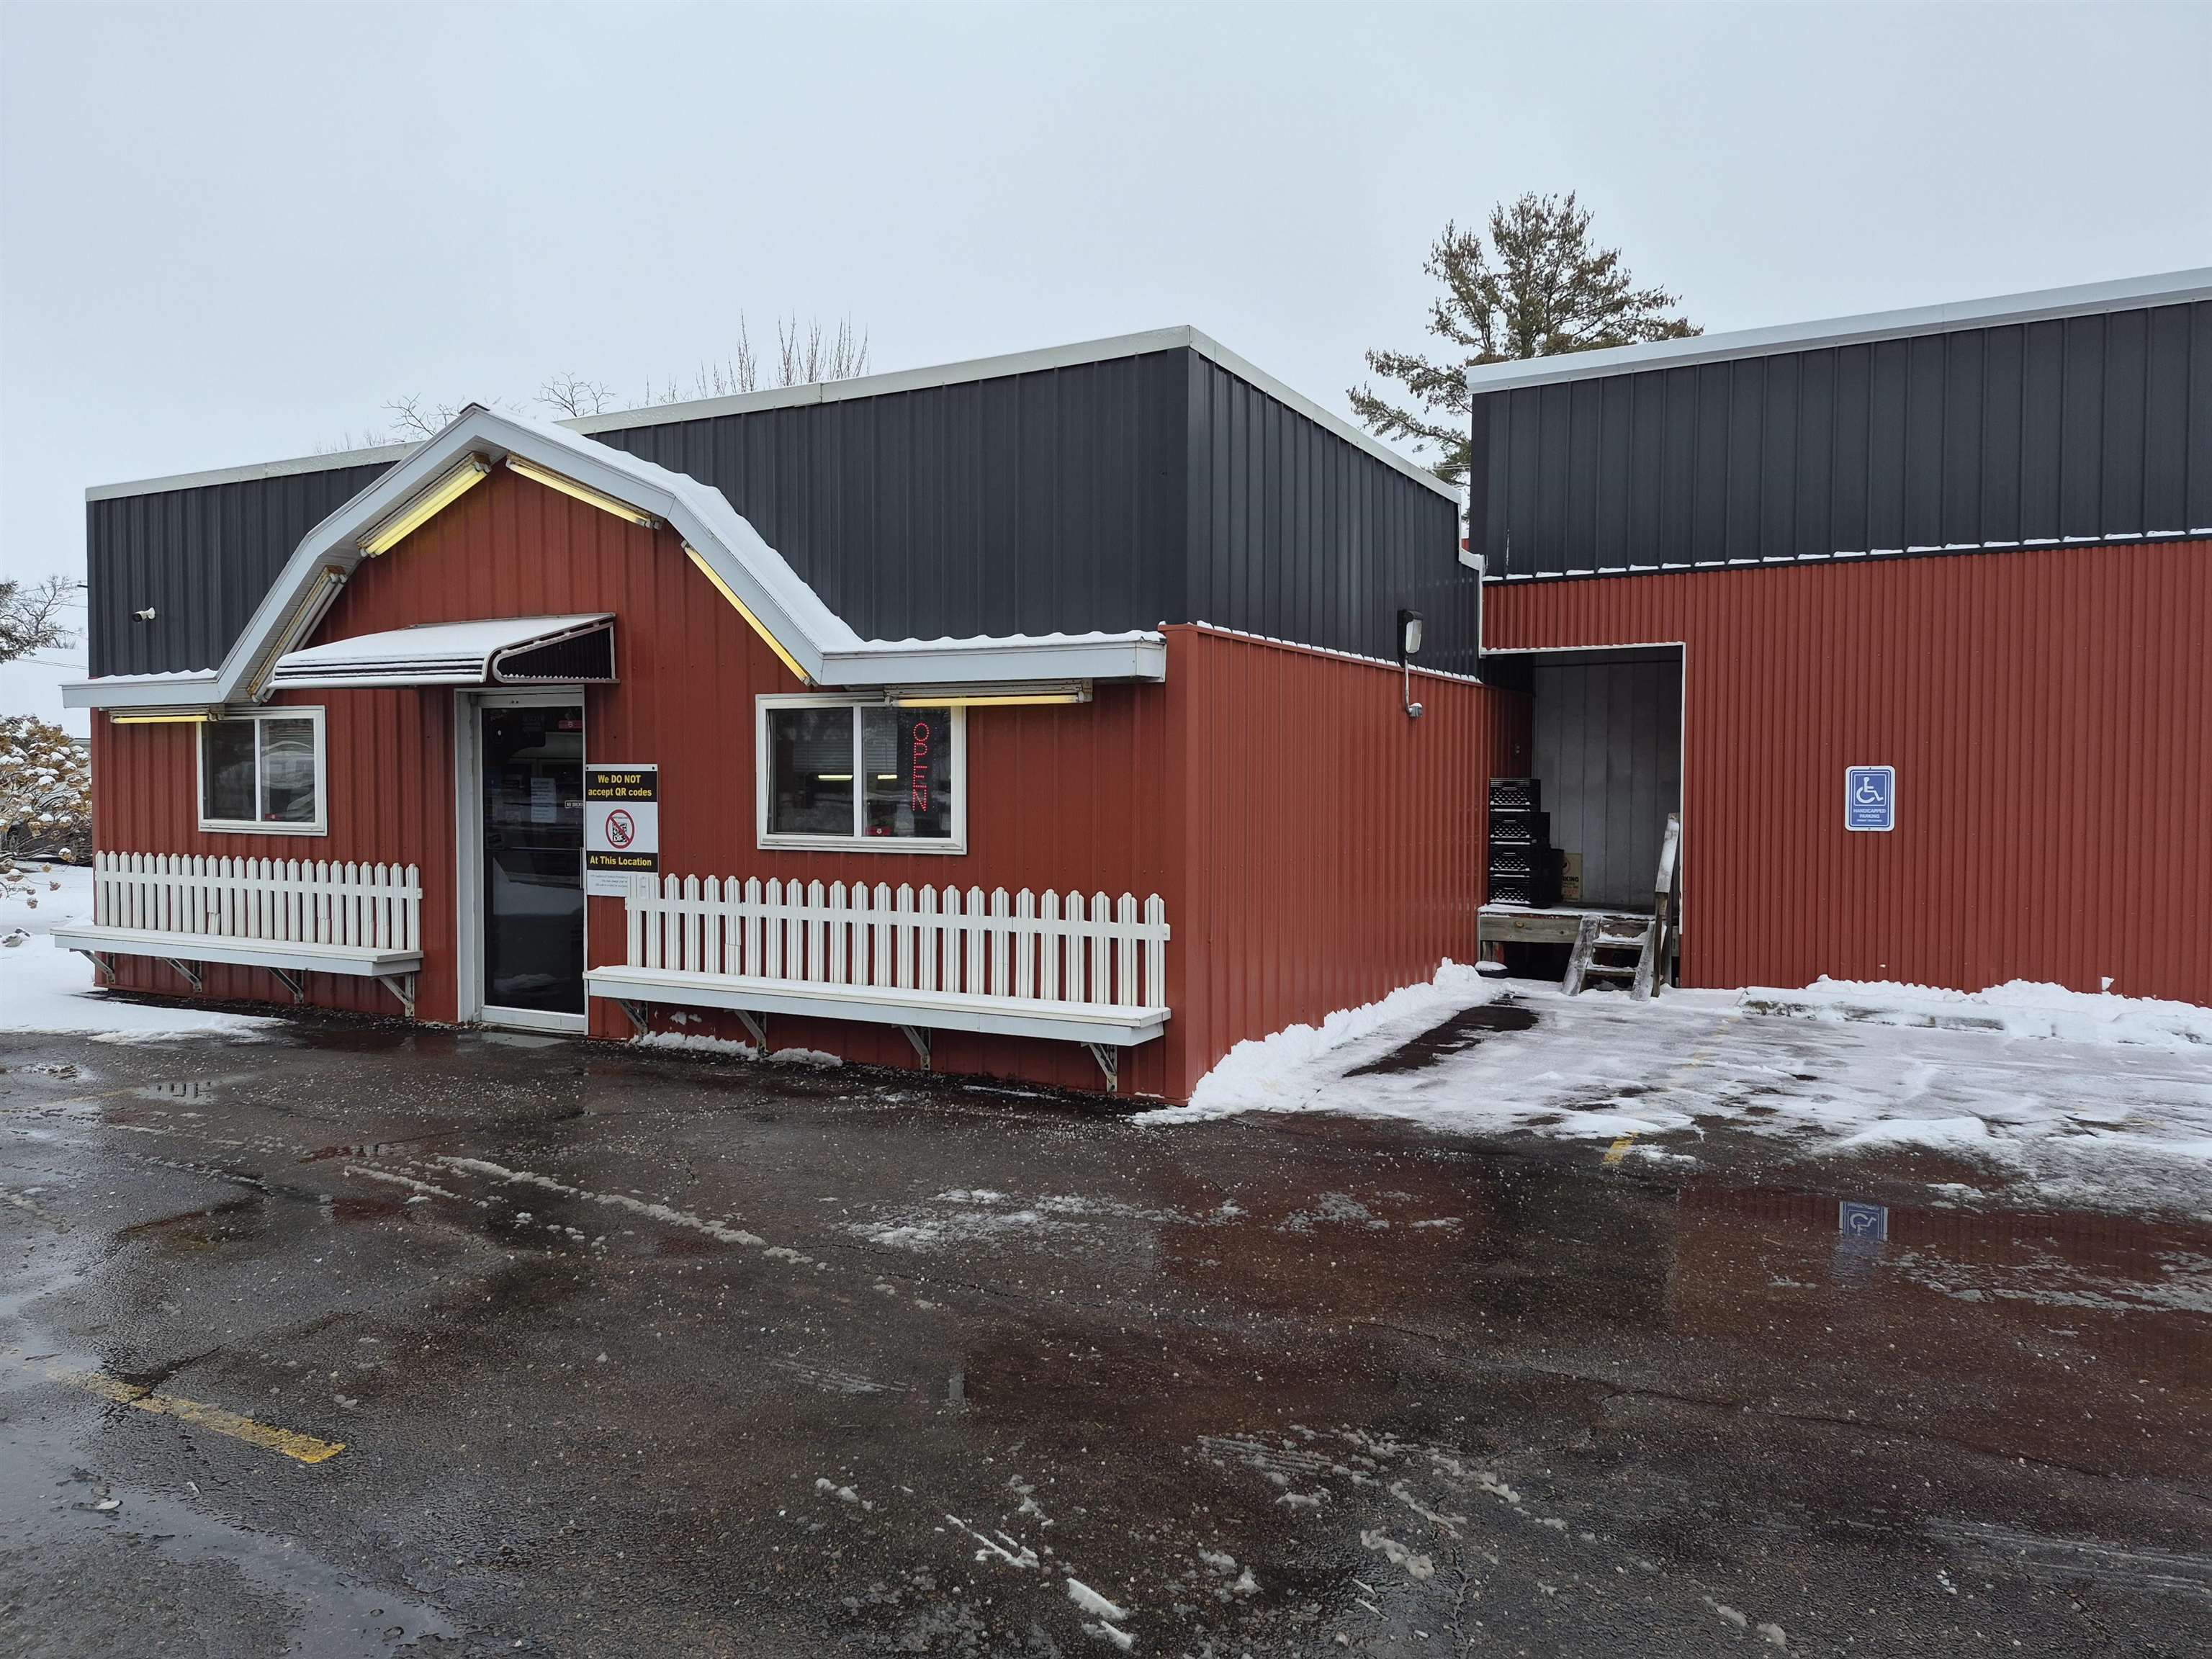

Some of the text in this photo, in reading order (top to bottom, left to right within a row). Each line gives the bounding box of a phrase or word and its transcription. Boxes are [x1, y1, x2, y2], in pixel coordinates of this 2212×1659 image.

[912, 721, 930, 812] OPEN
[598, 775, 641, 783] We DO NOT
[588, 788, 652, 798] accept QR codes
[590, 855, 652, 866] At This Location
